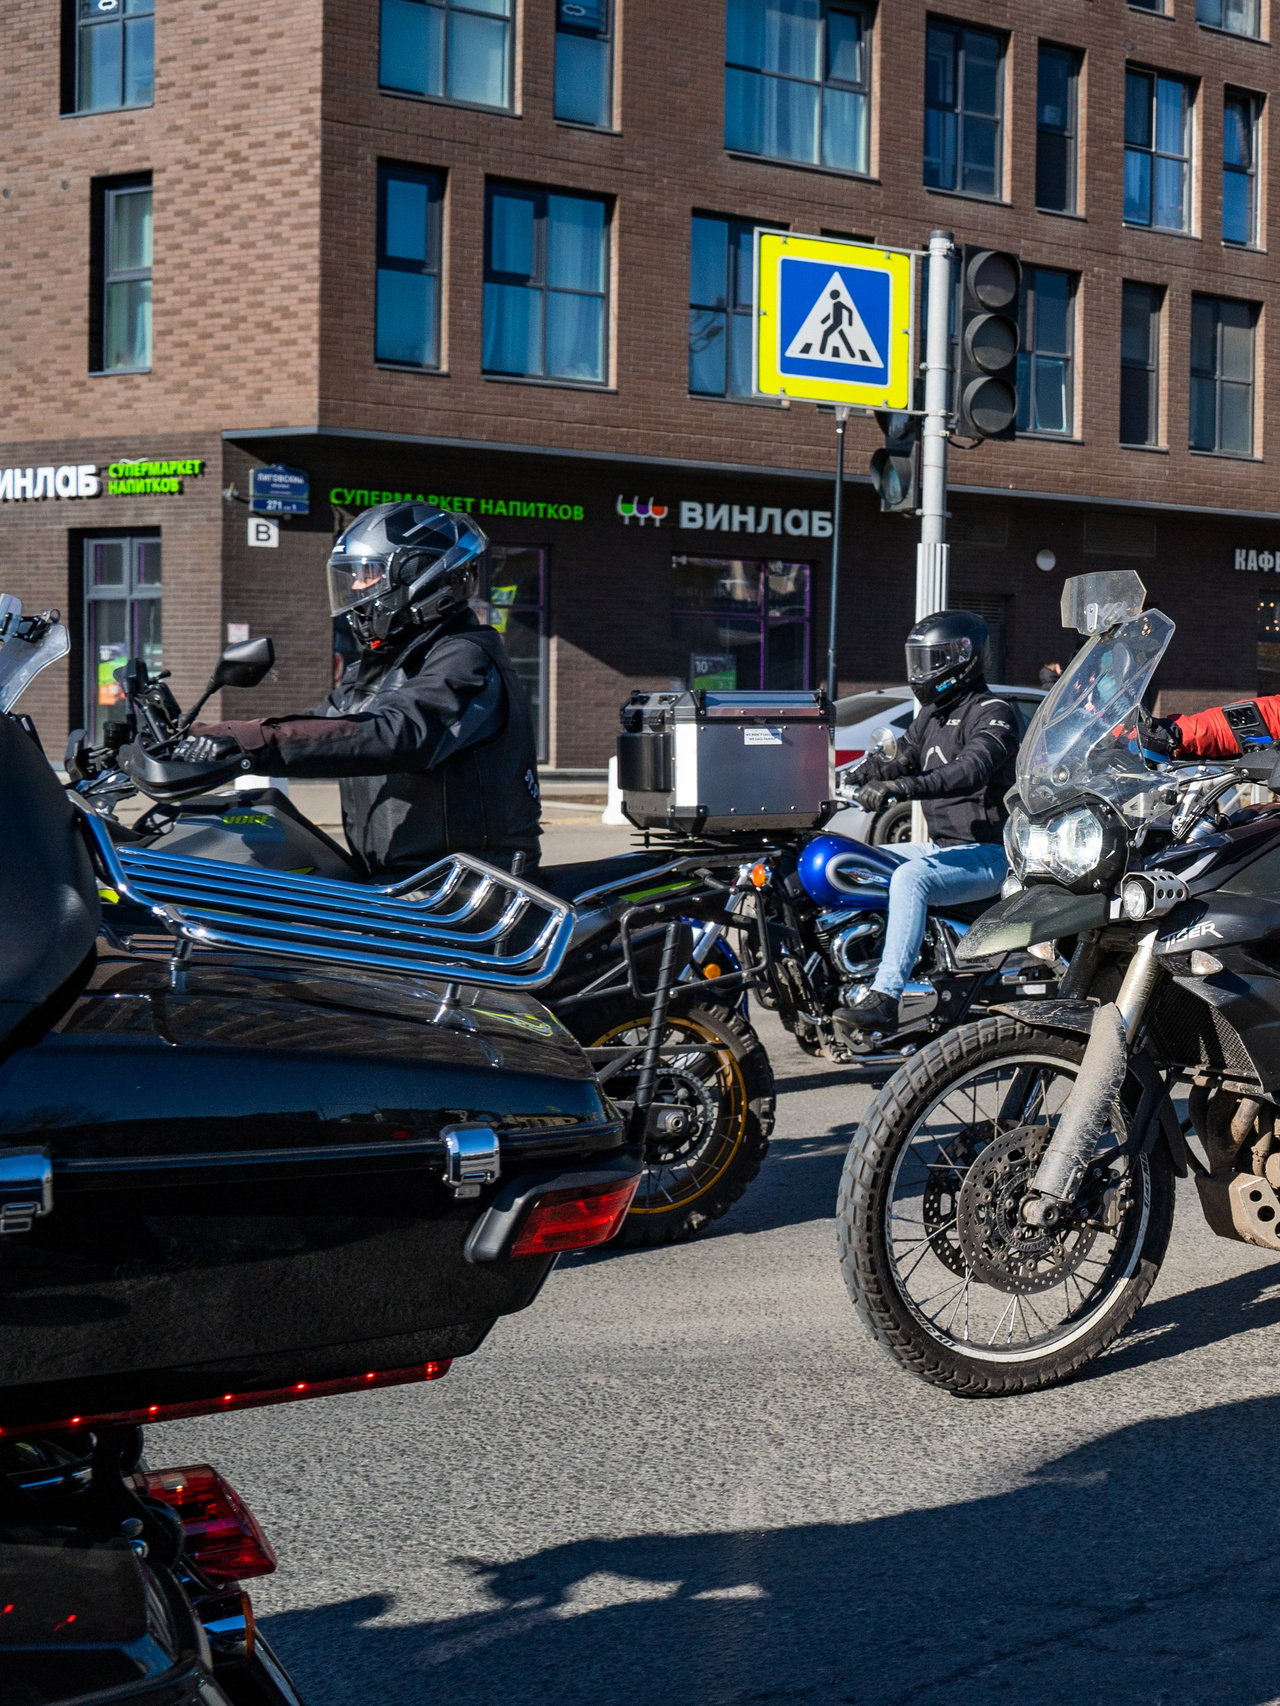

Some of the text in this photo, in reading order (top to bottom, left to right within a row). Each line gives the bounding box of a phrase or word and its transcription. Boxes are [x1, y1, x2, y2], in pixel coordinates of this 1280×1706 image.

[108, 459, 202, 478] СУПЕРМАРКЕТ
[108, 477, 180, 495] НАПИТКОВ
[266, 499, 282, 510] 271
[480, 498, 585, 521] НАПИТКОВ
[680, 500, 833, 538] ВИНЛАБ
[1160, 920, 1224, 952] TIGER
